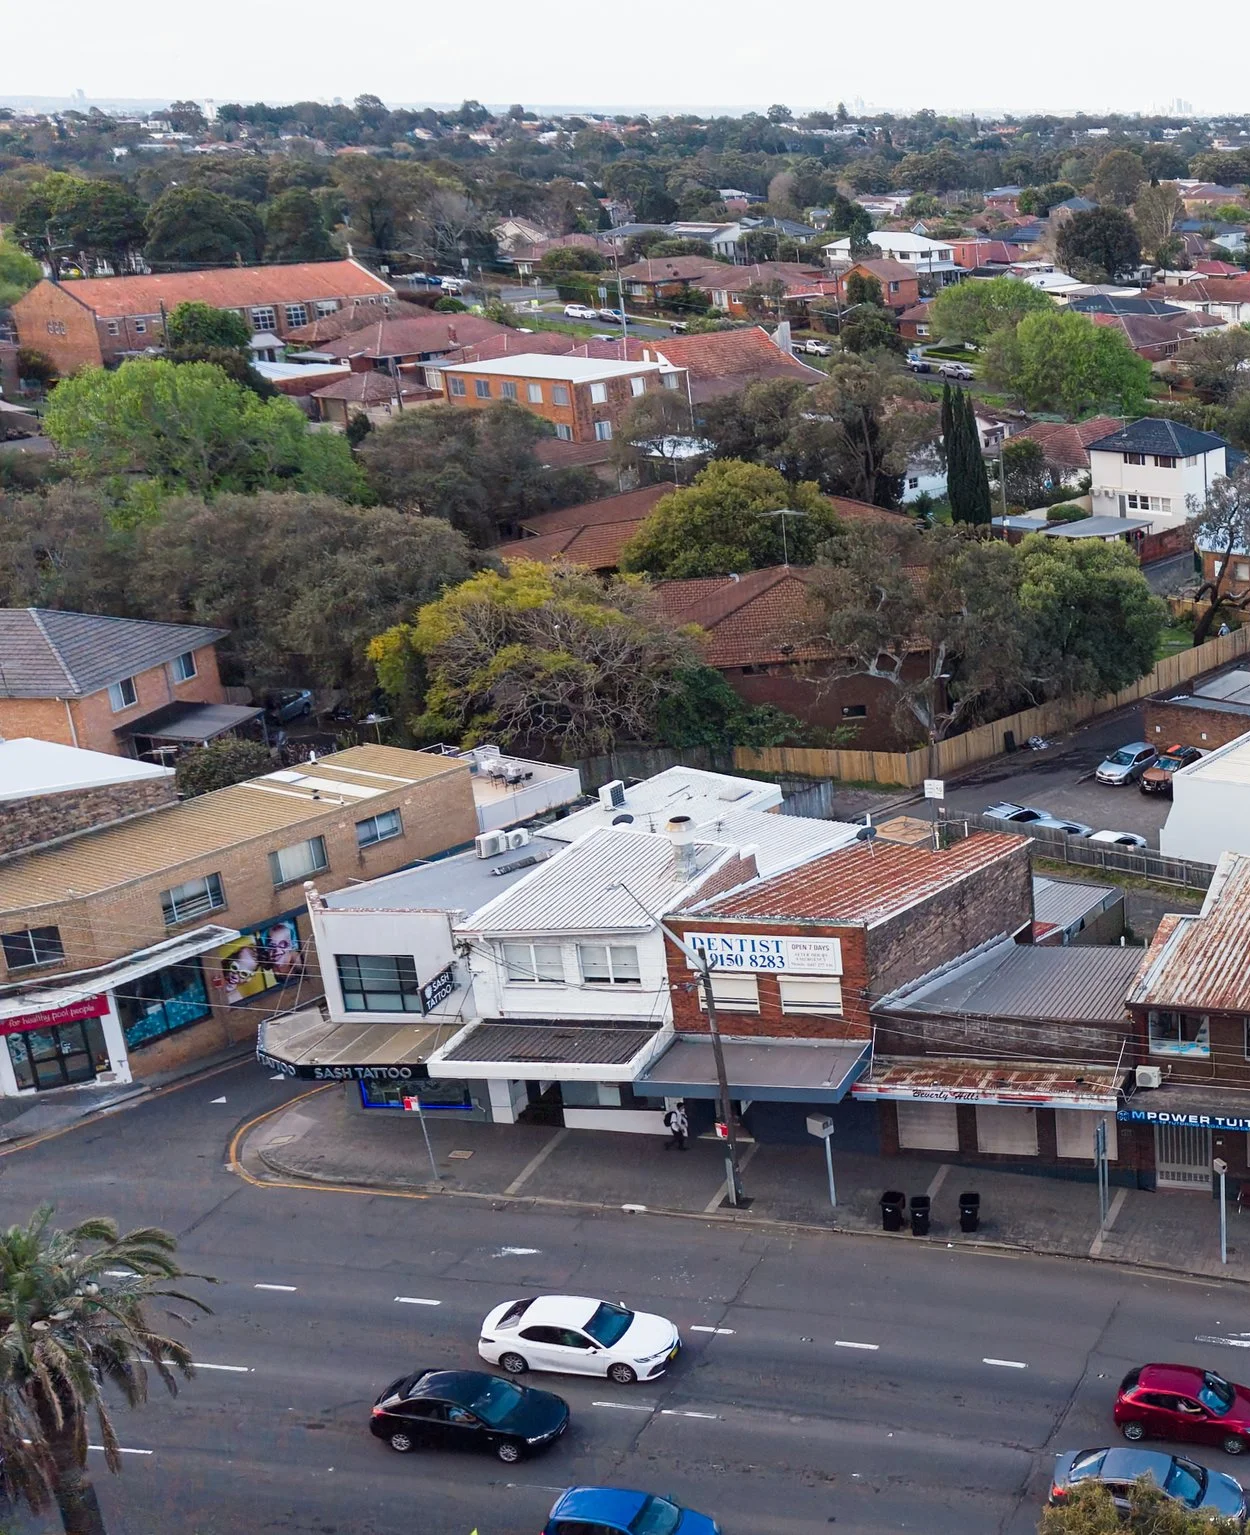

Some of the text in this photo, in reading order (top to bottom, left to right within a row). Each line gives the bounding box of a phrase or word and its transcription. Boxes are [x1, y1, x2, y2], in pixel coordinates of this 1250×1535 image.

[691, 936, 784, 953] DENTIST
[791, 943, 807, 951] OPEN
[709, 952, 785, 969] 9150 8283
[432, 972, 450, 991] SASH
[426, 984, 452, 1010] TATTOO
[8, 1004, 95, 1028] for healthy pool people
[259, 1052, 296, 1076] TATTOO
[314, 1067, 412, 1079] SASH TATTOO
[912, 1089, 979, 1101] Beverly Hills
[1131, 1111, 1210, 1125] MPOWER
